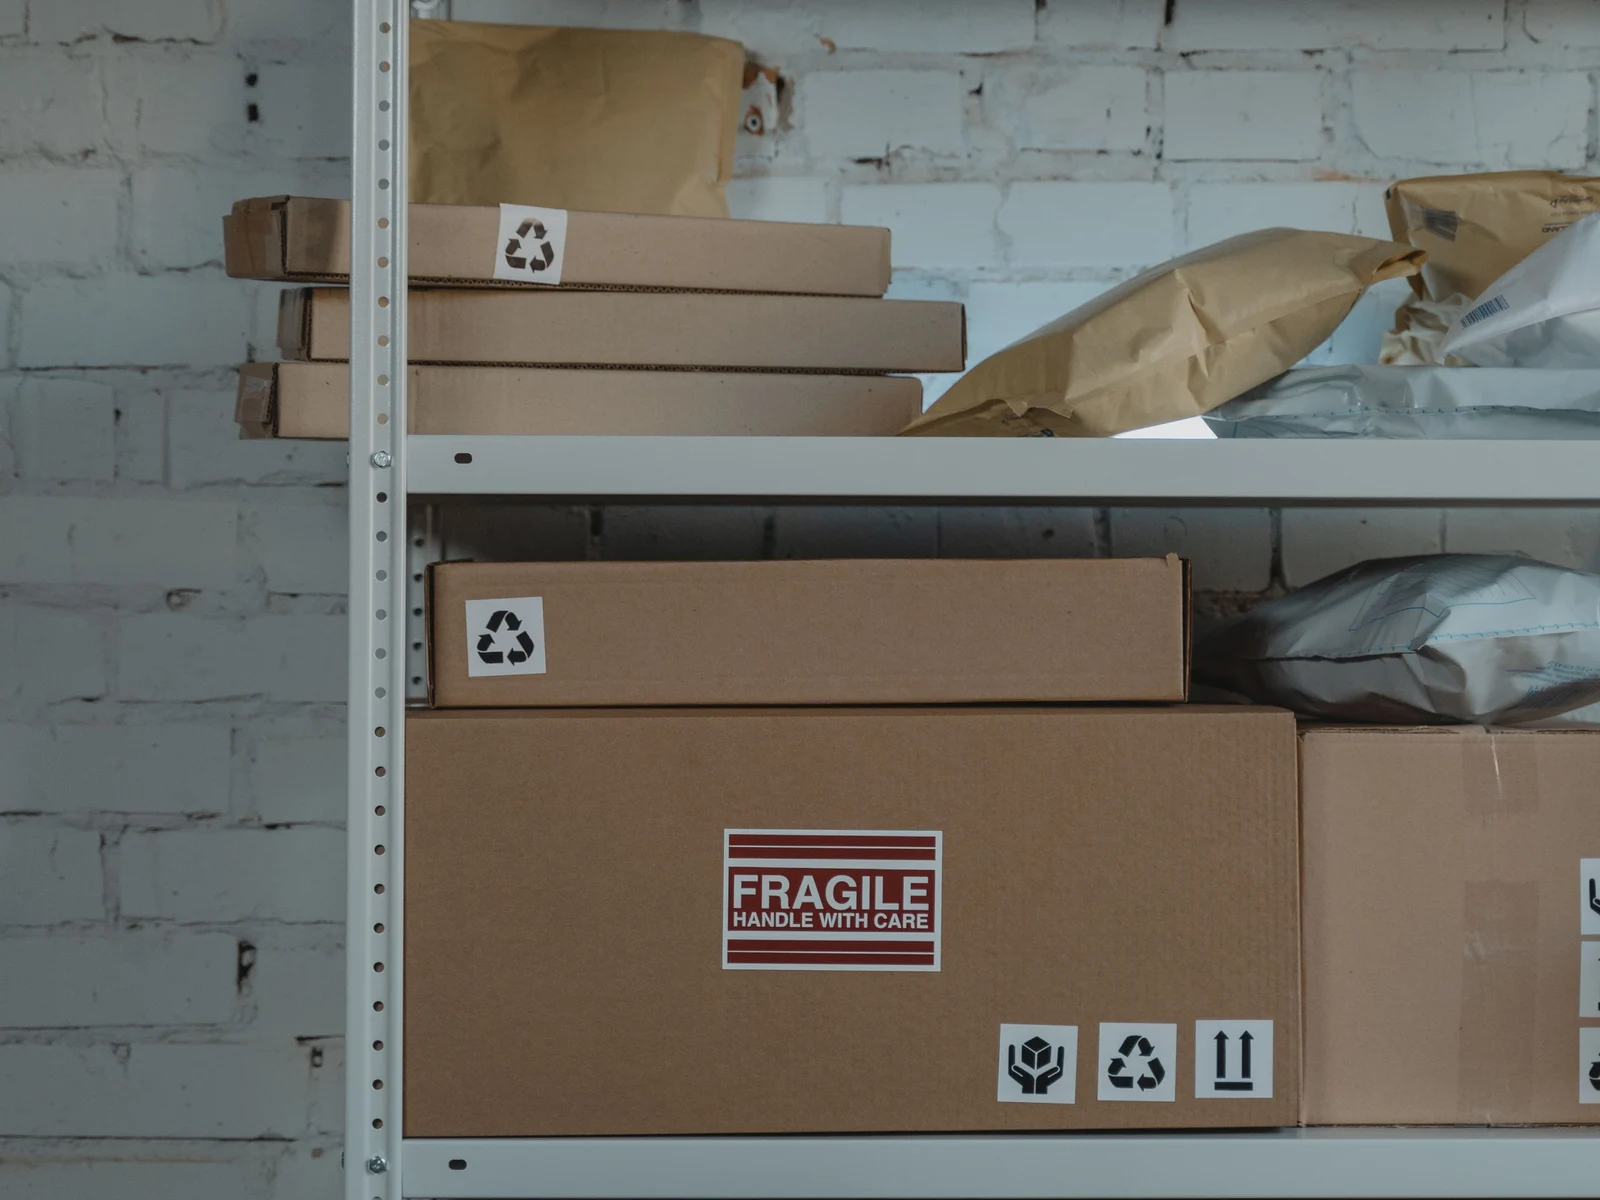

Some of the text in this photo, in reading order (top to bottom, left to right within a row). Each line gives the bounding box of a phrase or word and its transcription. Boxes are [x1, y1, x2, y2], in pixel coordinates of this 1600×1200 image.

[733, 874, 929, 911] FRAGILE
[733, 911, 929, 929] HANDLE WITH CARE
